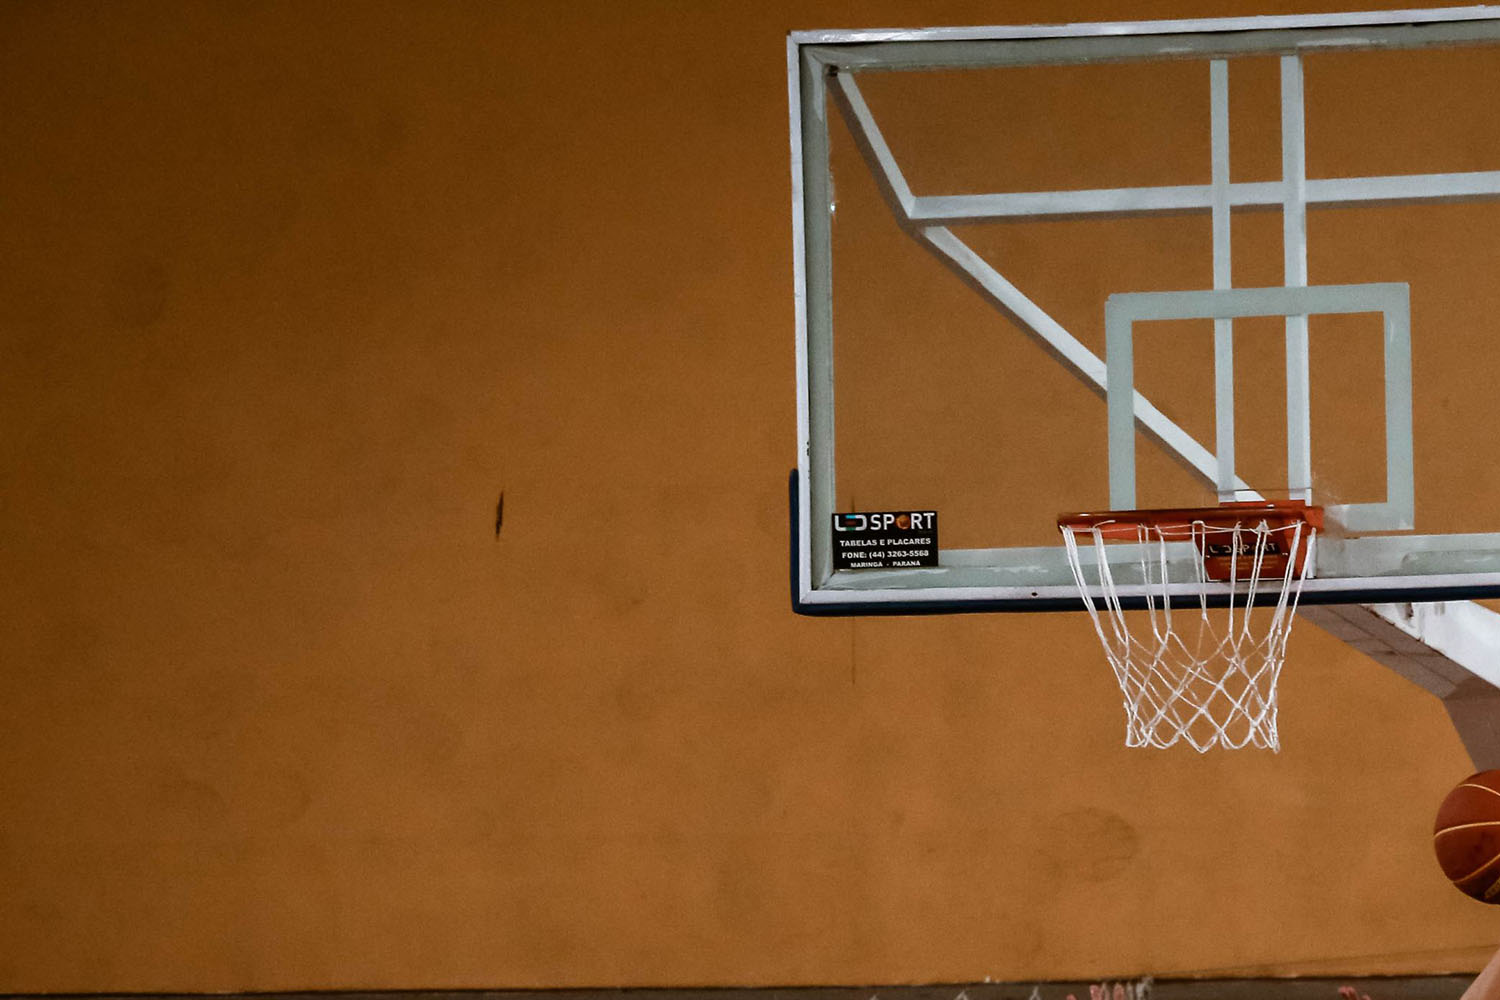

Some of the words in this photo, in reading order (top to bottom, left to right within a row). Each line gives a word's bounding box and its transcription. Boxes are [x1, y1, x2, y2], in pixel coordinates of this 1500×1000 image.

[840, 539, 878, 547] TABELAS
[887, 537, 932, 545] PLACARES
[841, 551, 867, 559] FONE:
[868, 551, 885, 559] (44)
